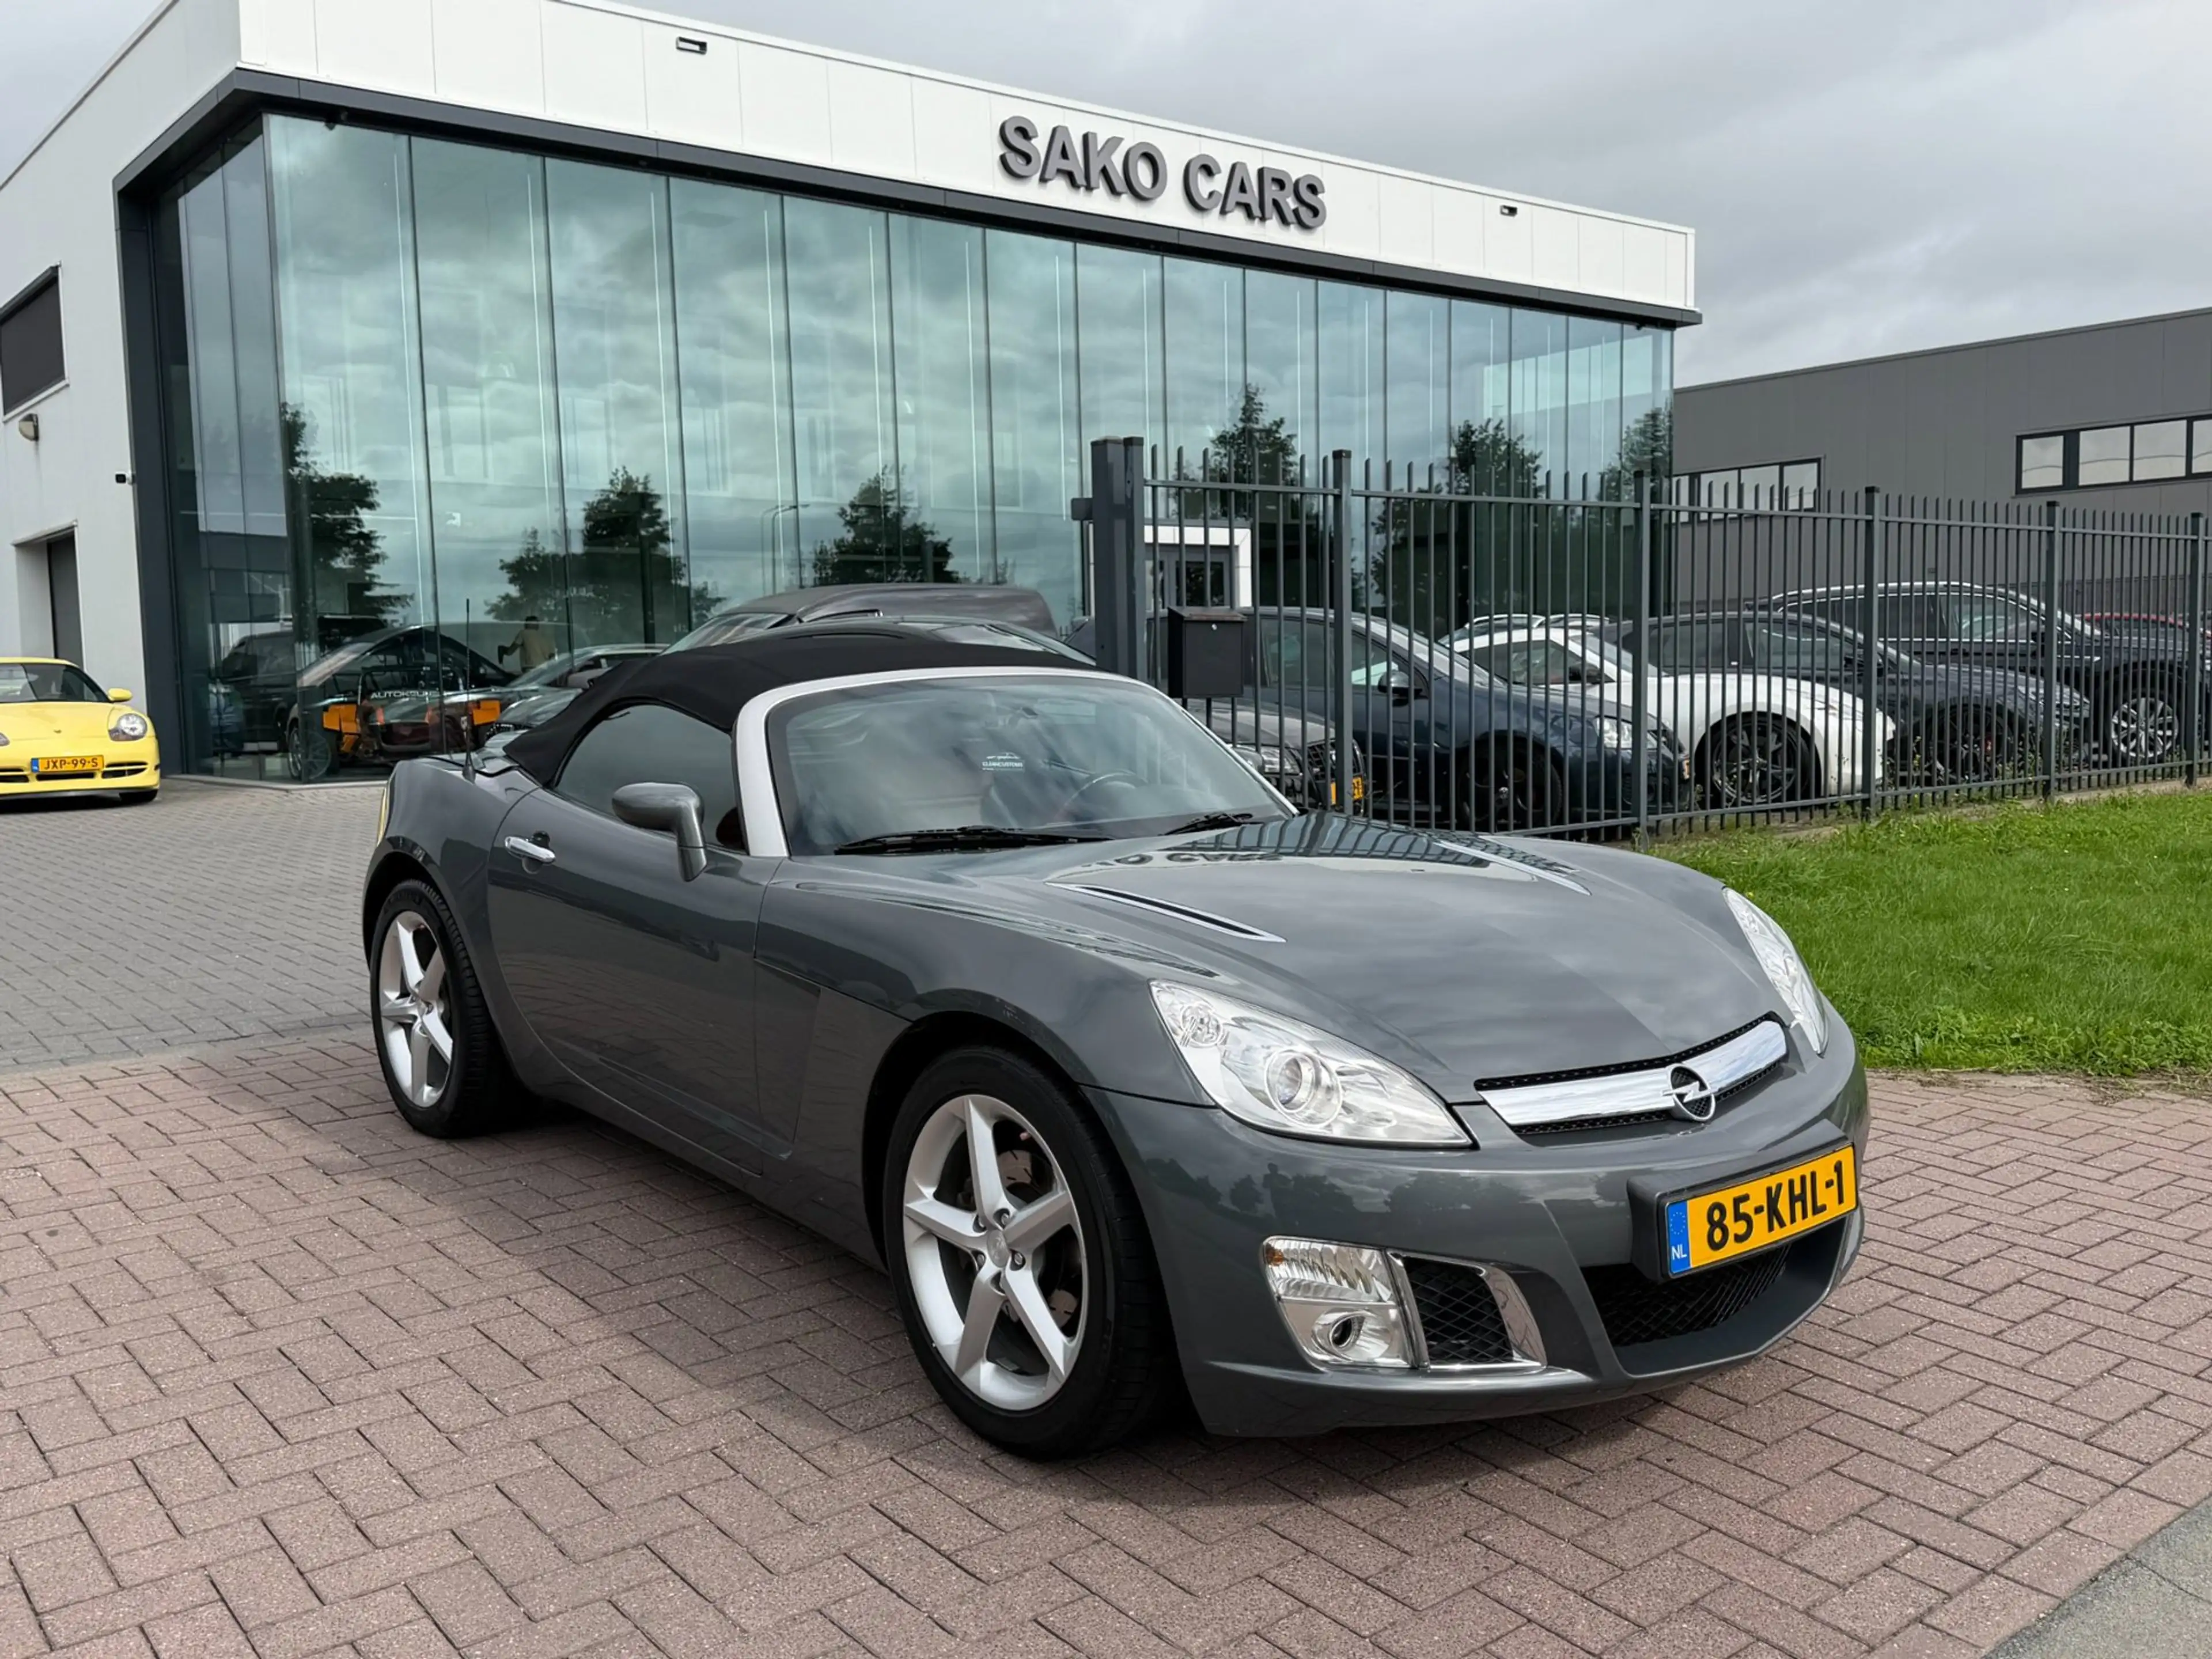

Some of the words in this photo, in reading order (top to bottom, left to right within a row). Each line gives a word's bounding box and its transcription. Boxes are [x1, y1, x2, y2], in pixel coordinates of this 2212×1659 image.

[999, 116, 1168, 201] SAKO
[1183, 154, 1327, 229] CARS
[44, 757, 99, 770] JXP-99-S
[1706, 1160, 1844, 1252] 85-KHL-1
[1672, 1244, 1687, 1260] NL
